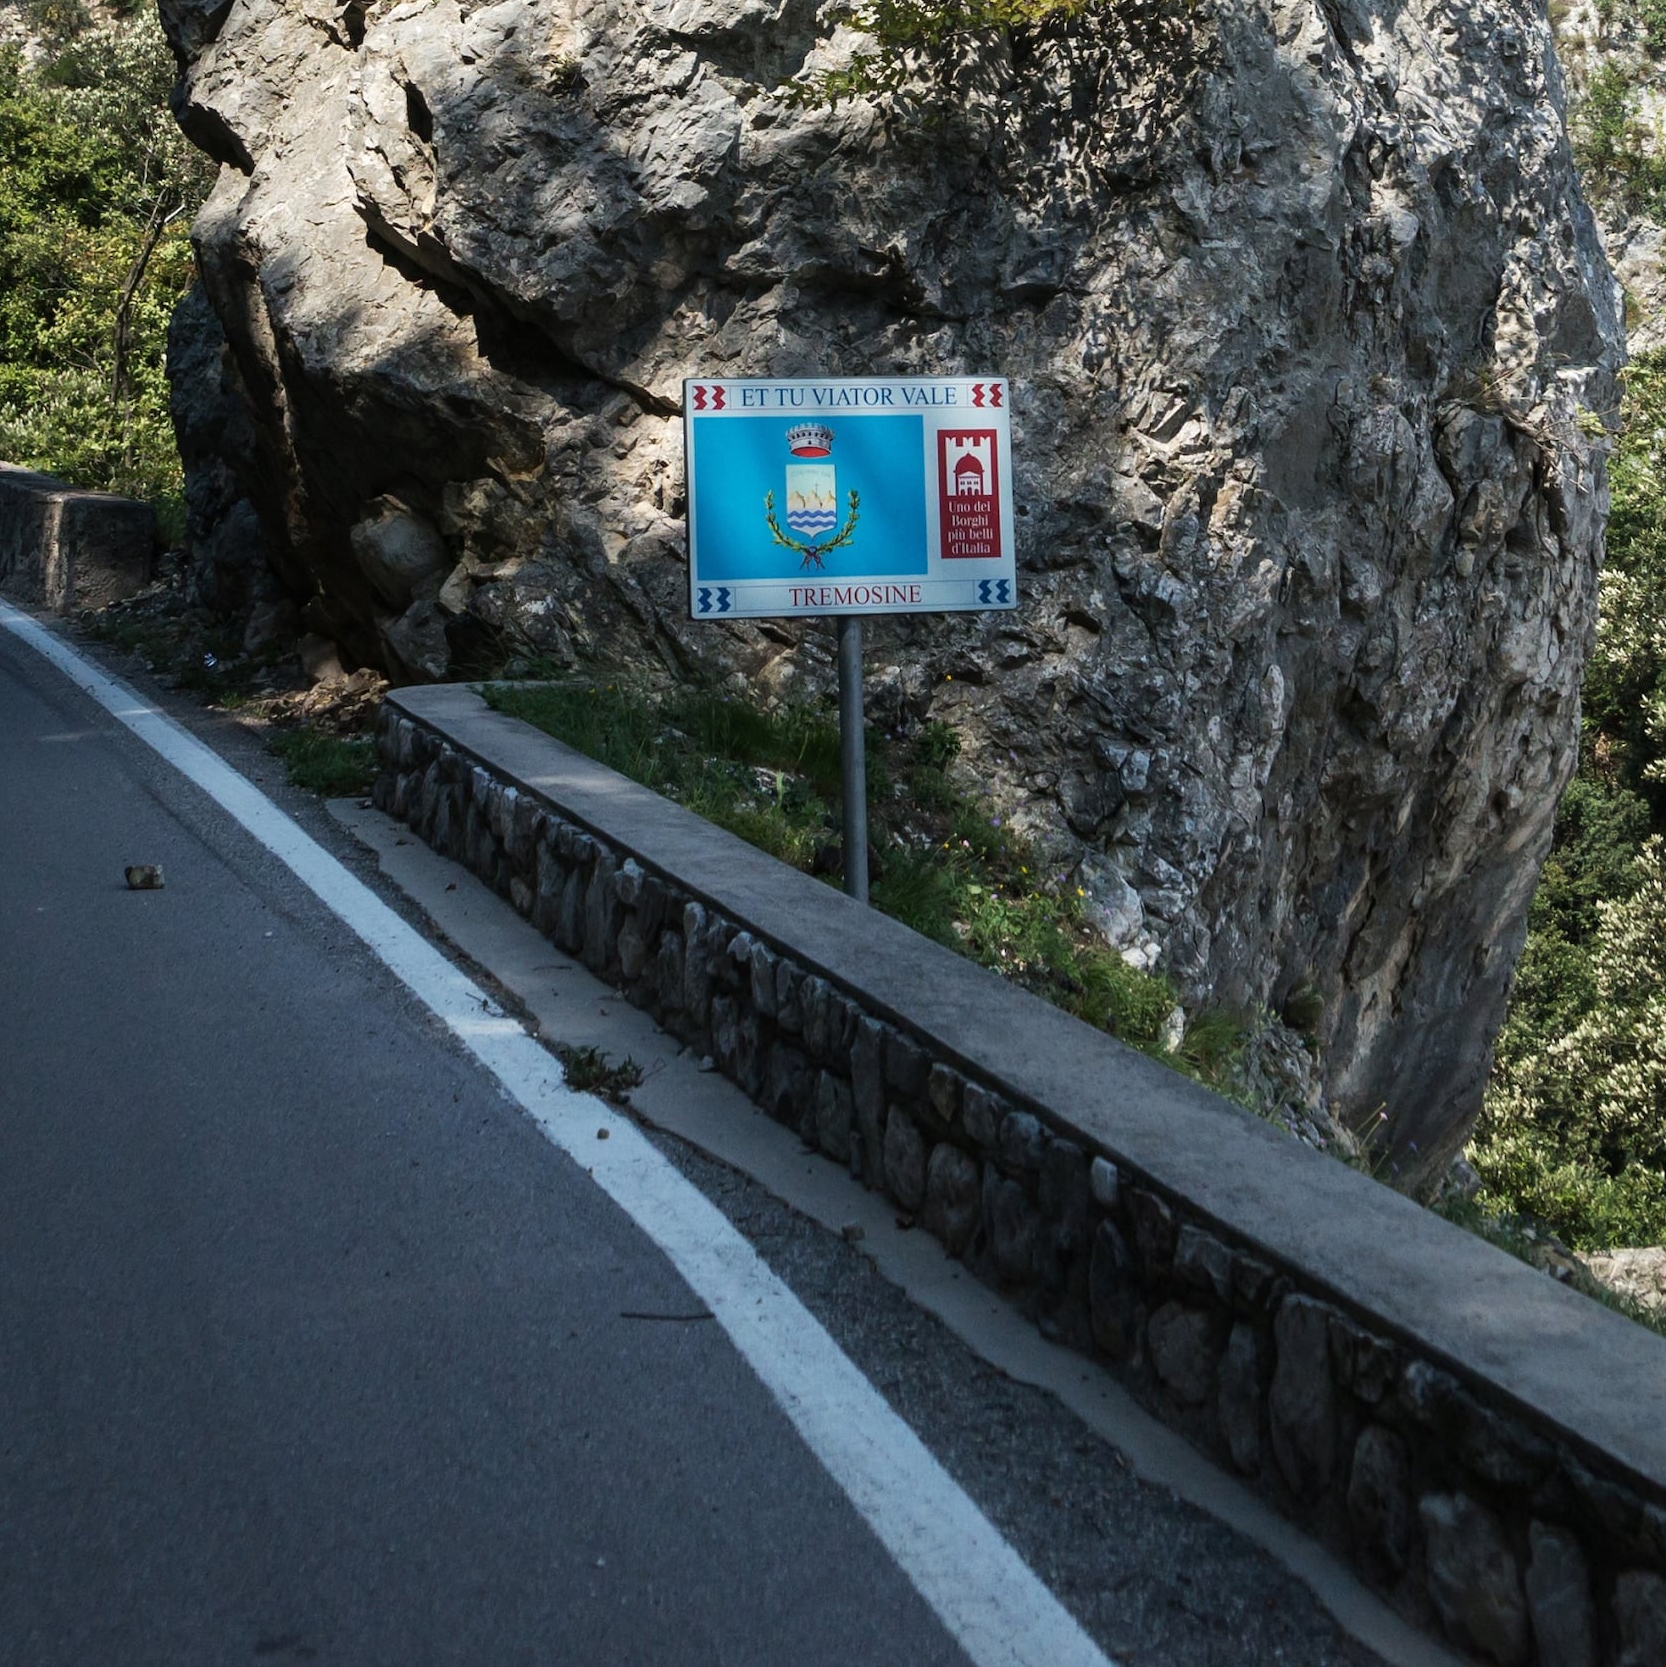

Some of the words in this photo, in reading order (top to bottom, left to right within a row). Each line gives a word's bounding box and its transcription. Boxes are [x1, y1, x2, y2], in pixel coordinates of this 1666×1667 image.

[742, 388, 769, 406] ET
[775, 388, 805, 406] TU
[812, 387, 894, 406] VIATOR
[901, 387, 957, 405] VALE
[949, 501, 970, 513] Uno
[974, 500, 991, 512] dei
[952, 514, 989, 528] Borghi
[948, 528, 966, 543] più
[969, 528, 993, 539] belli
[951, 542, 991, 554] d'Italia
[789, 585, 922, 606] TREMOSINE
